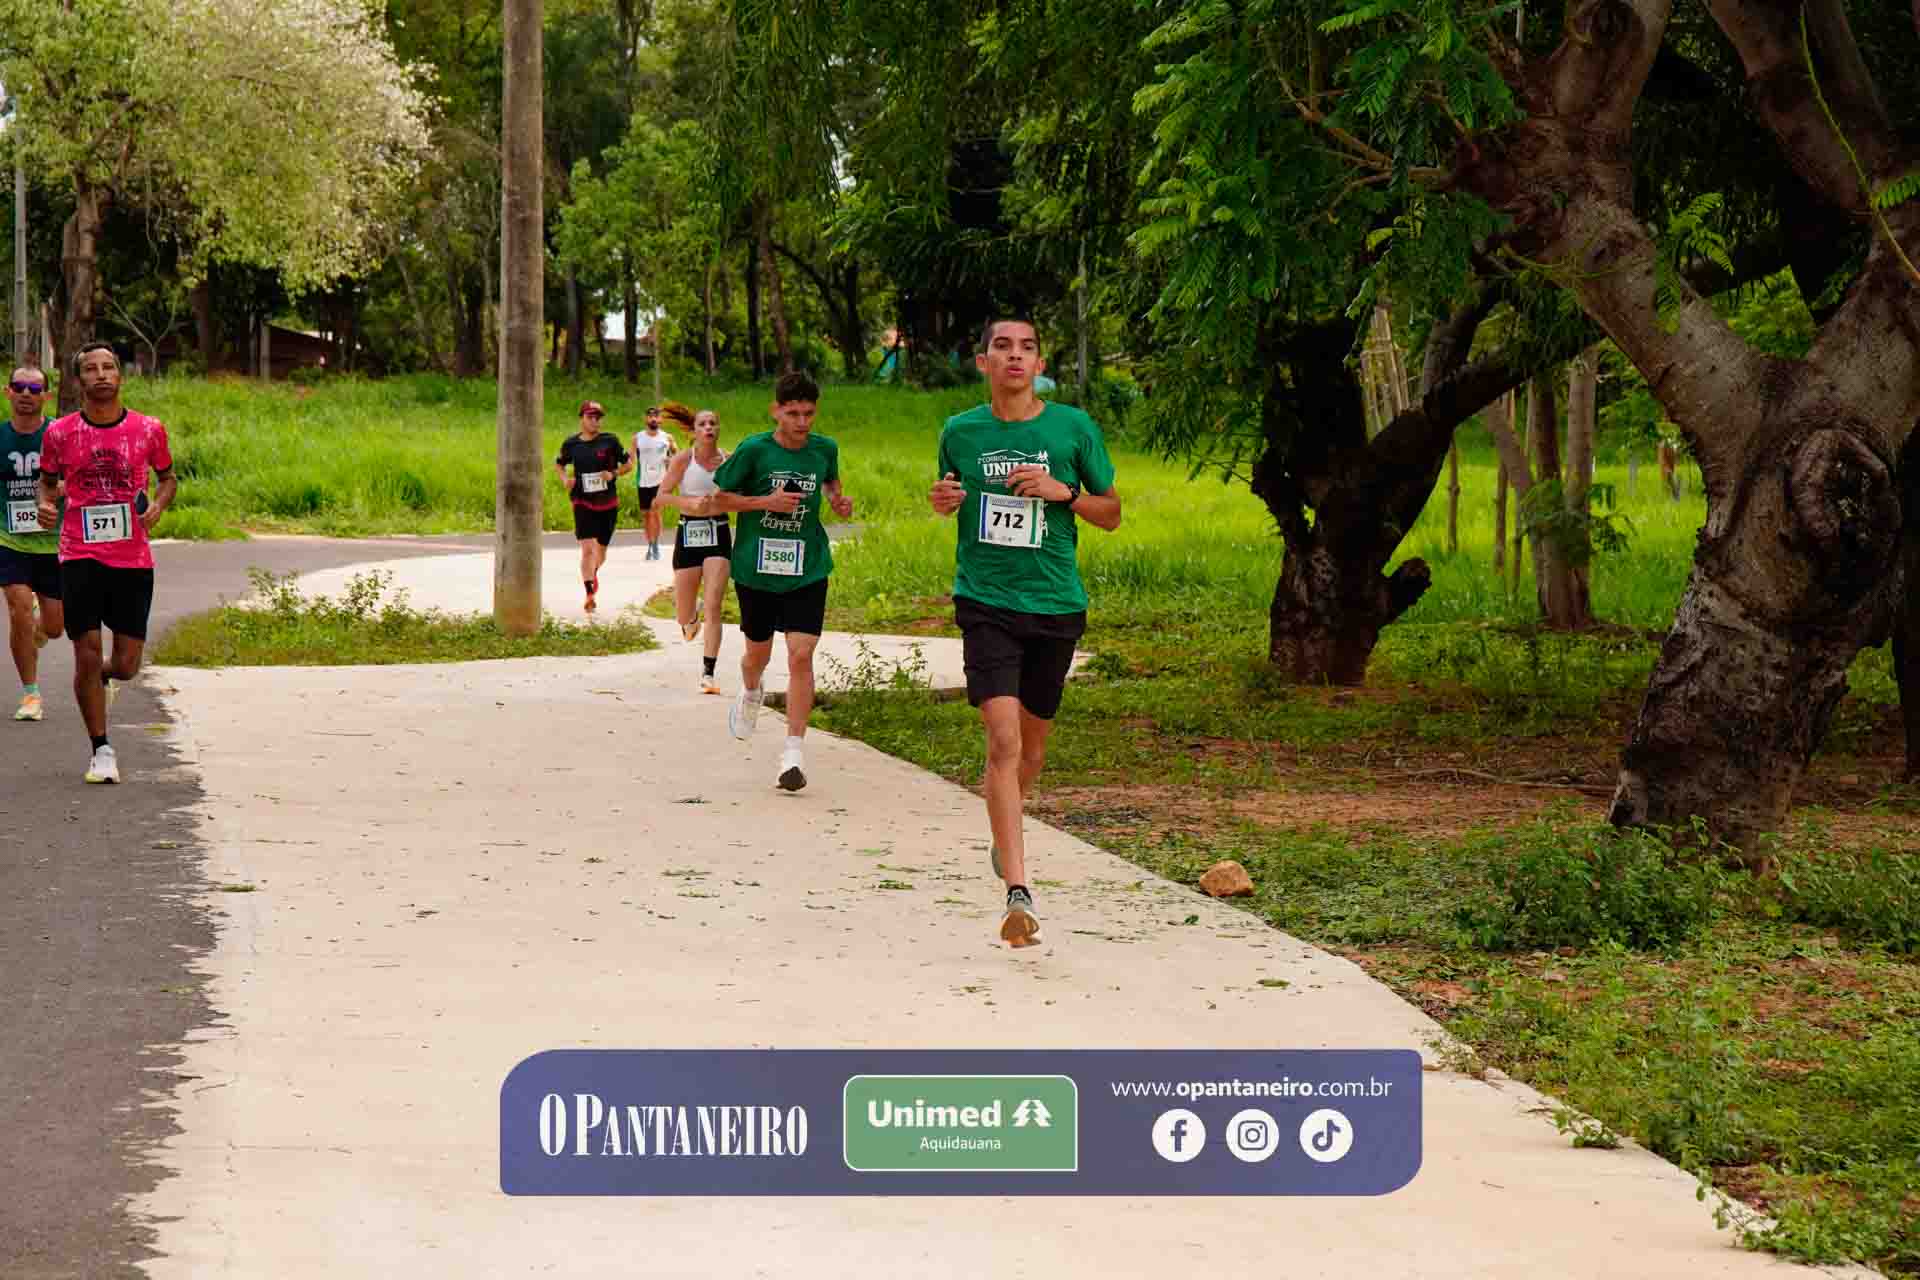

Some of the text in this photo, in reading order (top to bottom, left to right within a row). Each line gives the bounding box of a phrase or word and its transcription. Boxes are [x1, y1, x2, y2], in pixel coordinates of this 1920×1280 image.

[16, 511, 36, 522] 505
[992, 512, 1024, 529] 712
[93, 517, 116, 530] 571
[764, 551, 795, 562] 3580
